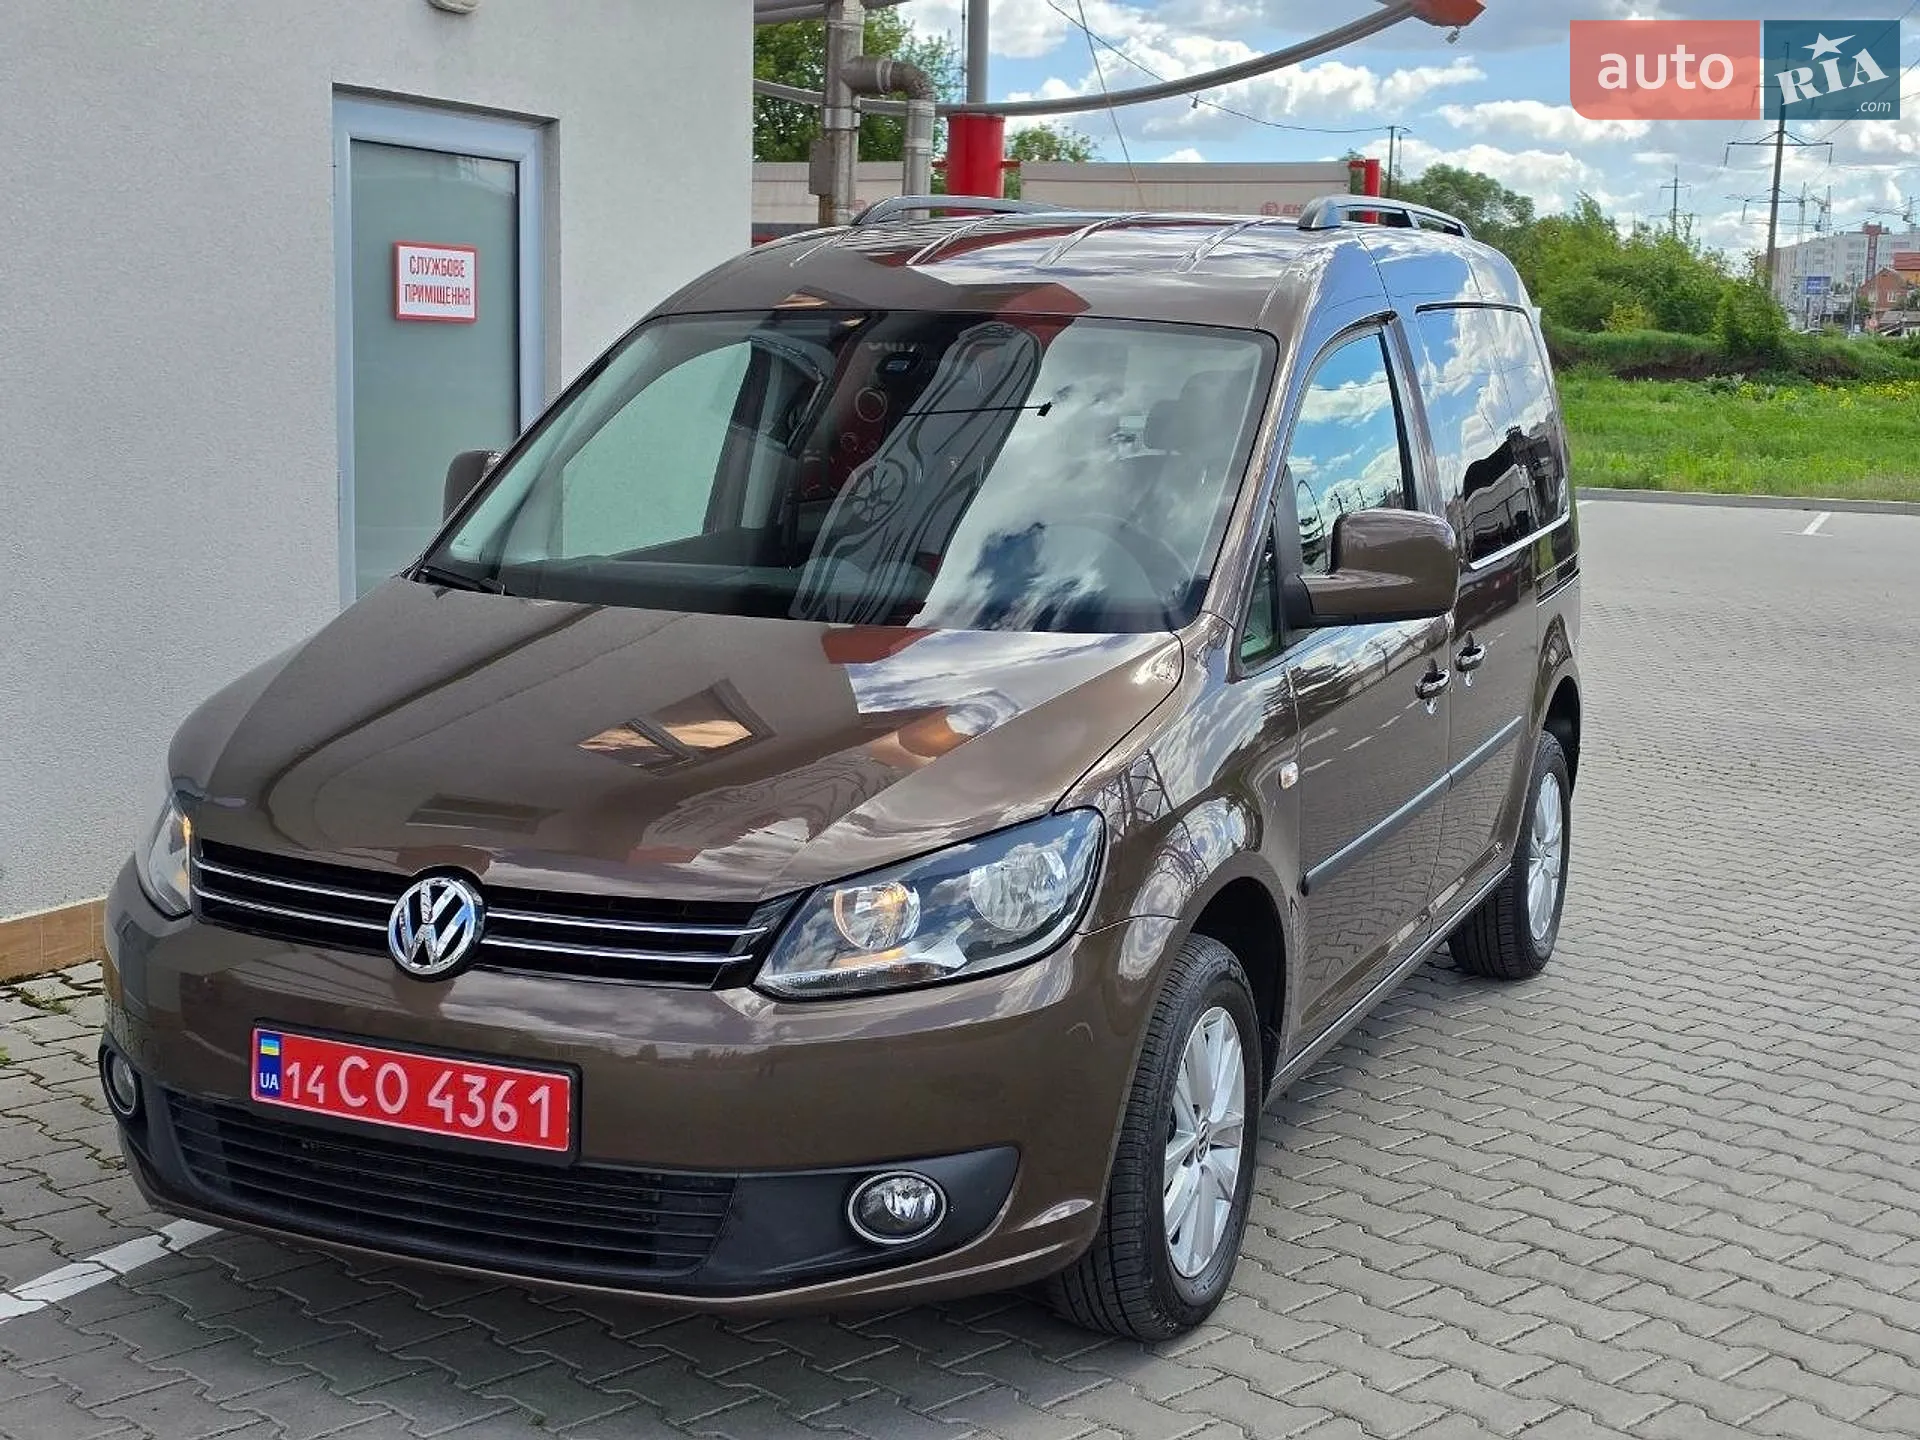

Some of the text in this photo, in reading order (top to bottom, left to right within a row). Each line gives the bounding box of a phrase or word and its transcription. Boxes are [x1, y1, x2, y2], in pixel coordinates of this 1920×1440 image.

[409, 255, 465, 278] СЛУЖБОВЕ
[405, 283, 471, 306] ПРИМІЩЕННЯ
[260, 1072, 279, 1090] UA
[286, 1062, 325, 1104] 14
[427, 1070, 551, 1138] 4361
